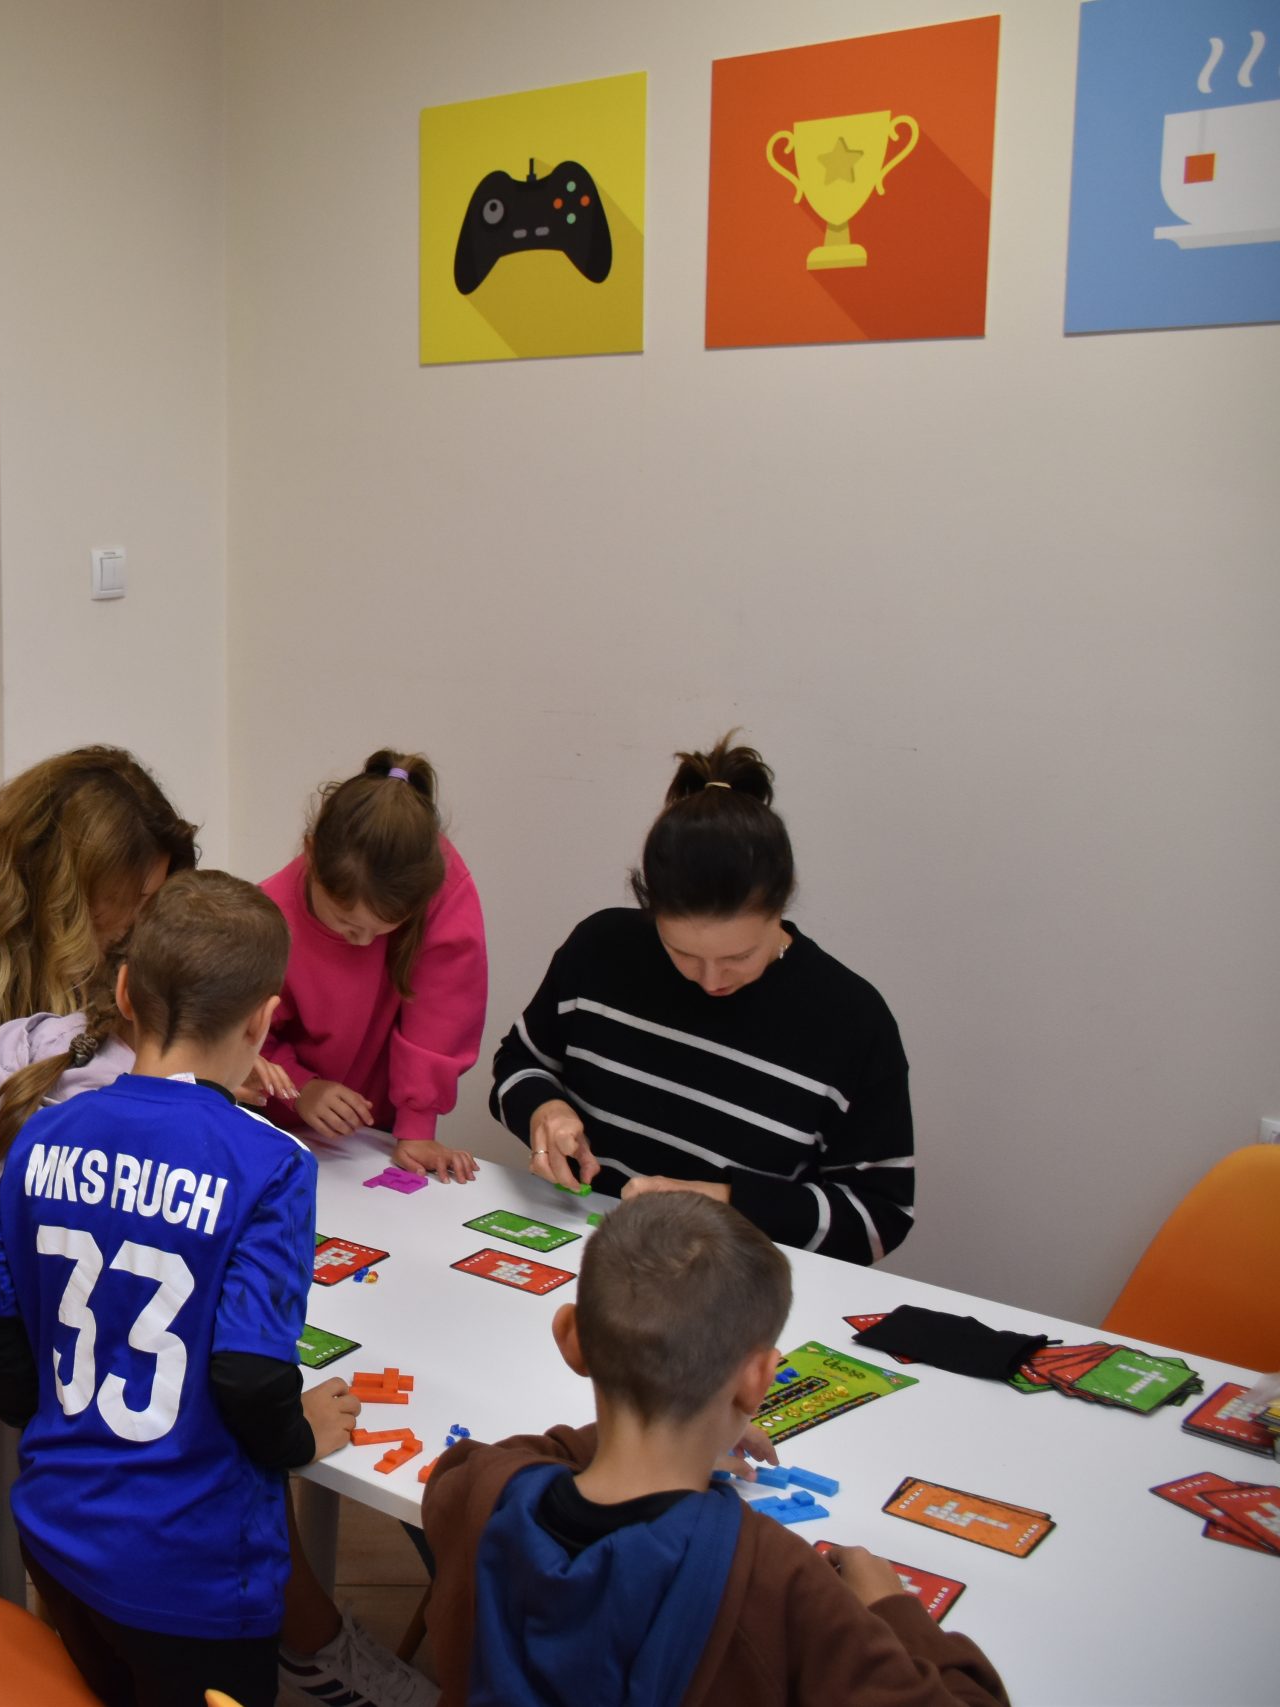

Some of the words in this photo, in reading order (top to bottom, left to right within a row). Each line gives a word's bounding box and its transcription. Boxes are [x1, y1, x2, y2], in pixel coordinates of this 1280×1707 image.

[24, 1143, 107, 1205] MKS
[110, 1152, 228, 1235] RUCH
[36, 1224, 195, 1443] 33
